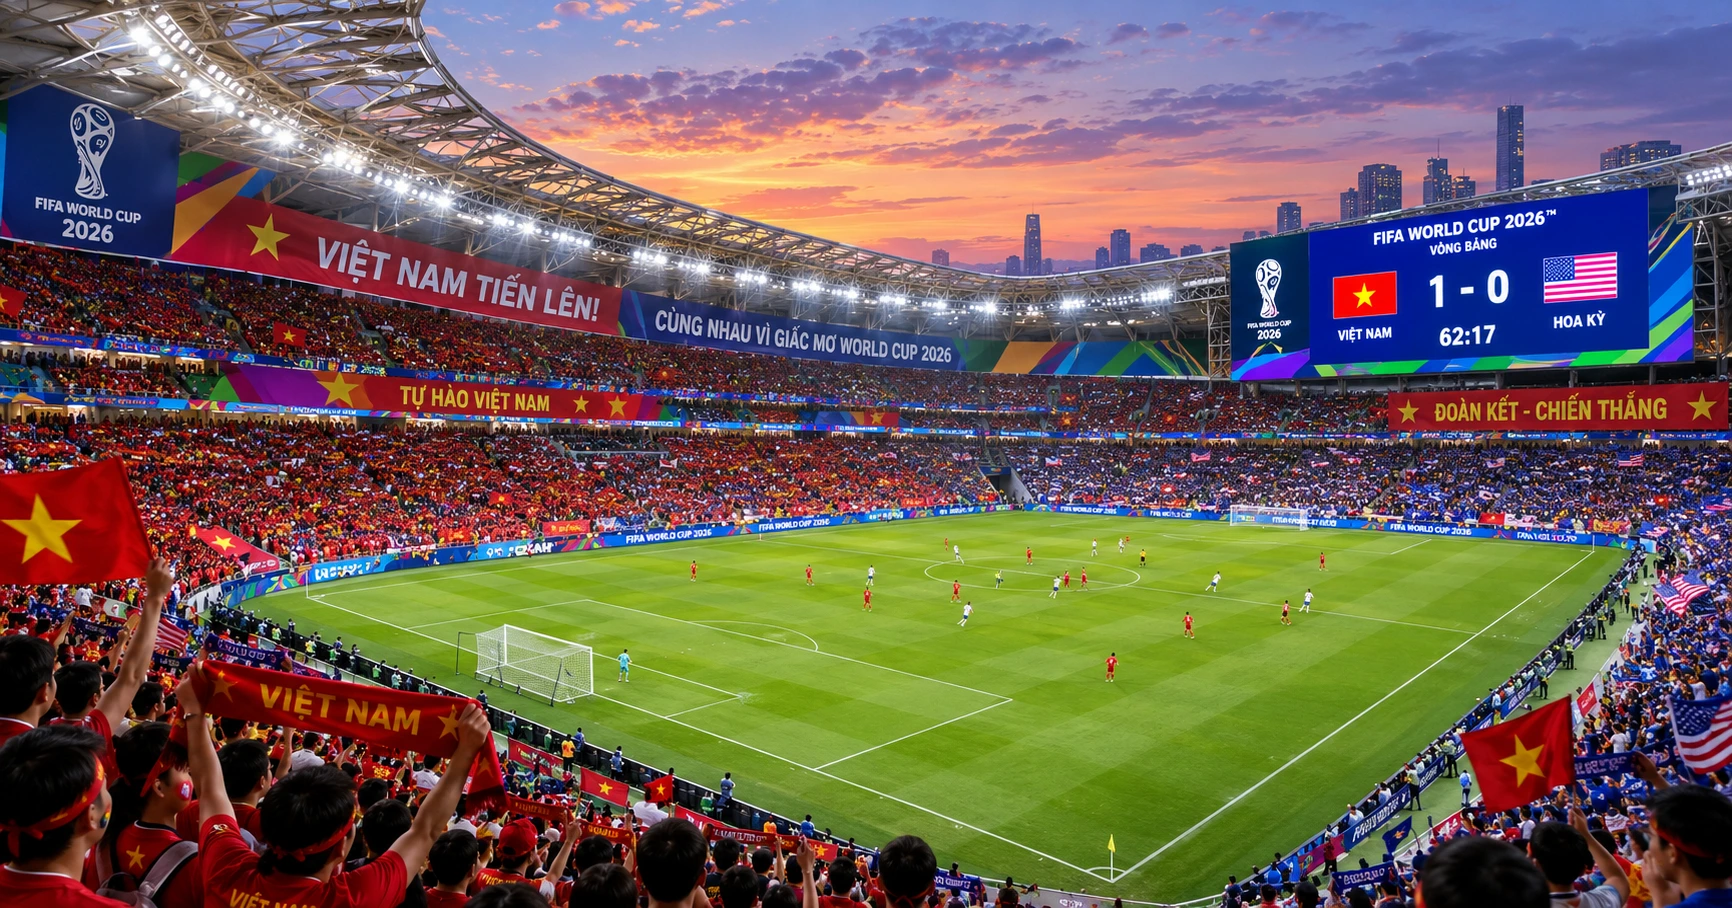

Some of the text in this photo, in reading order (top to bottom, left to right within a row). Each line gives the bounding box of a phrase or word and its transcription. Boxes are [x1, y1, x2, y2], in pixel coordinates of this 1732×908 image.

[35, 197, 141, 224] FIFA WORLD CUP
[62, 218, 114, 243] 2026
[1373, 229, 1404, 245] FIFA
[1408, 221, 1463, 241] WORLD
[1467, 216, 1500, 233] CUP
[317, 236, 600, 322] VIỆT NAM TIẾN LÊN!
[1429, 269, 1509, 308] 1 - 0
[1553, 310, 1606, 329] HOA KỲ
[654, 306, 951, 363] CÙNG NHAU VÌ GIẤC MƠ WORLD CUP 2026
[1257, 329, 1281, 340] 2026
[1337, 326, 1392, 343] VIỆT NAM
[1439, 324, 1496, 347] 62:17
[400, 384, 549, 413] TỰ HÀO VIỆT NAM
[1434, 397, 1481, 422] ĐOÀN
[1486, 394, 1519, 421] KẾT
[1535, 392, 1592, 421] CHIẾN
[1598, 390, 1667, 420] THẮNG
[259, 683, 422, 736] VIỆT NAM
